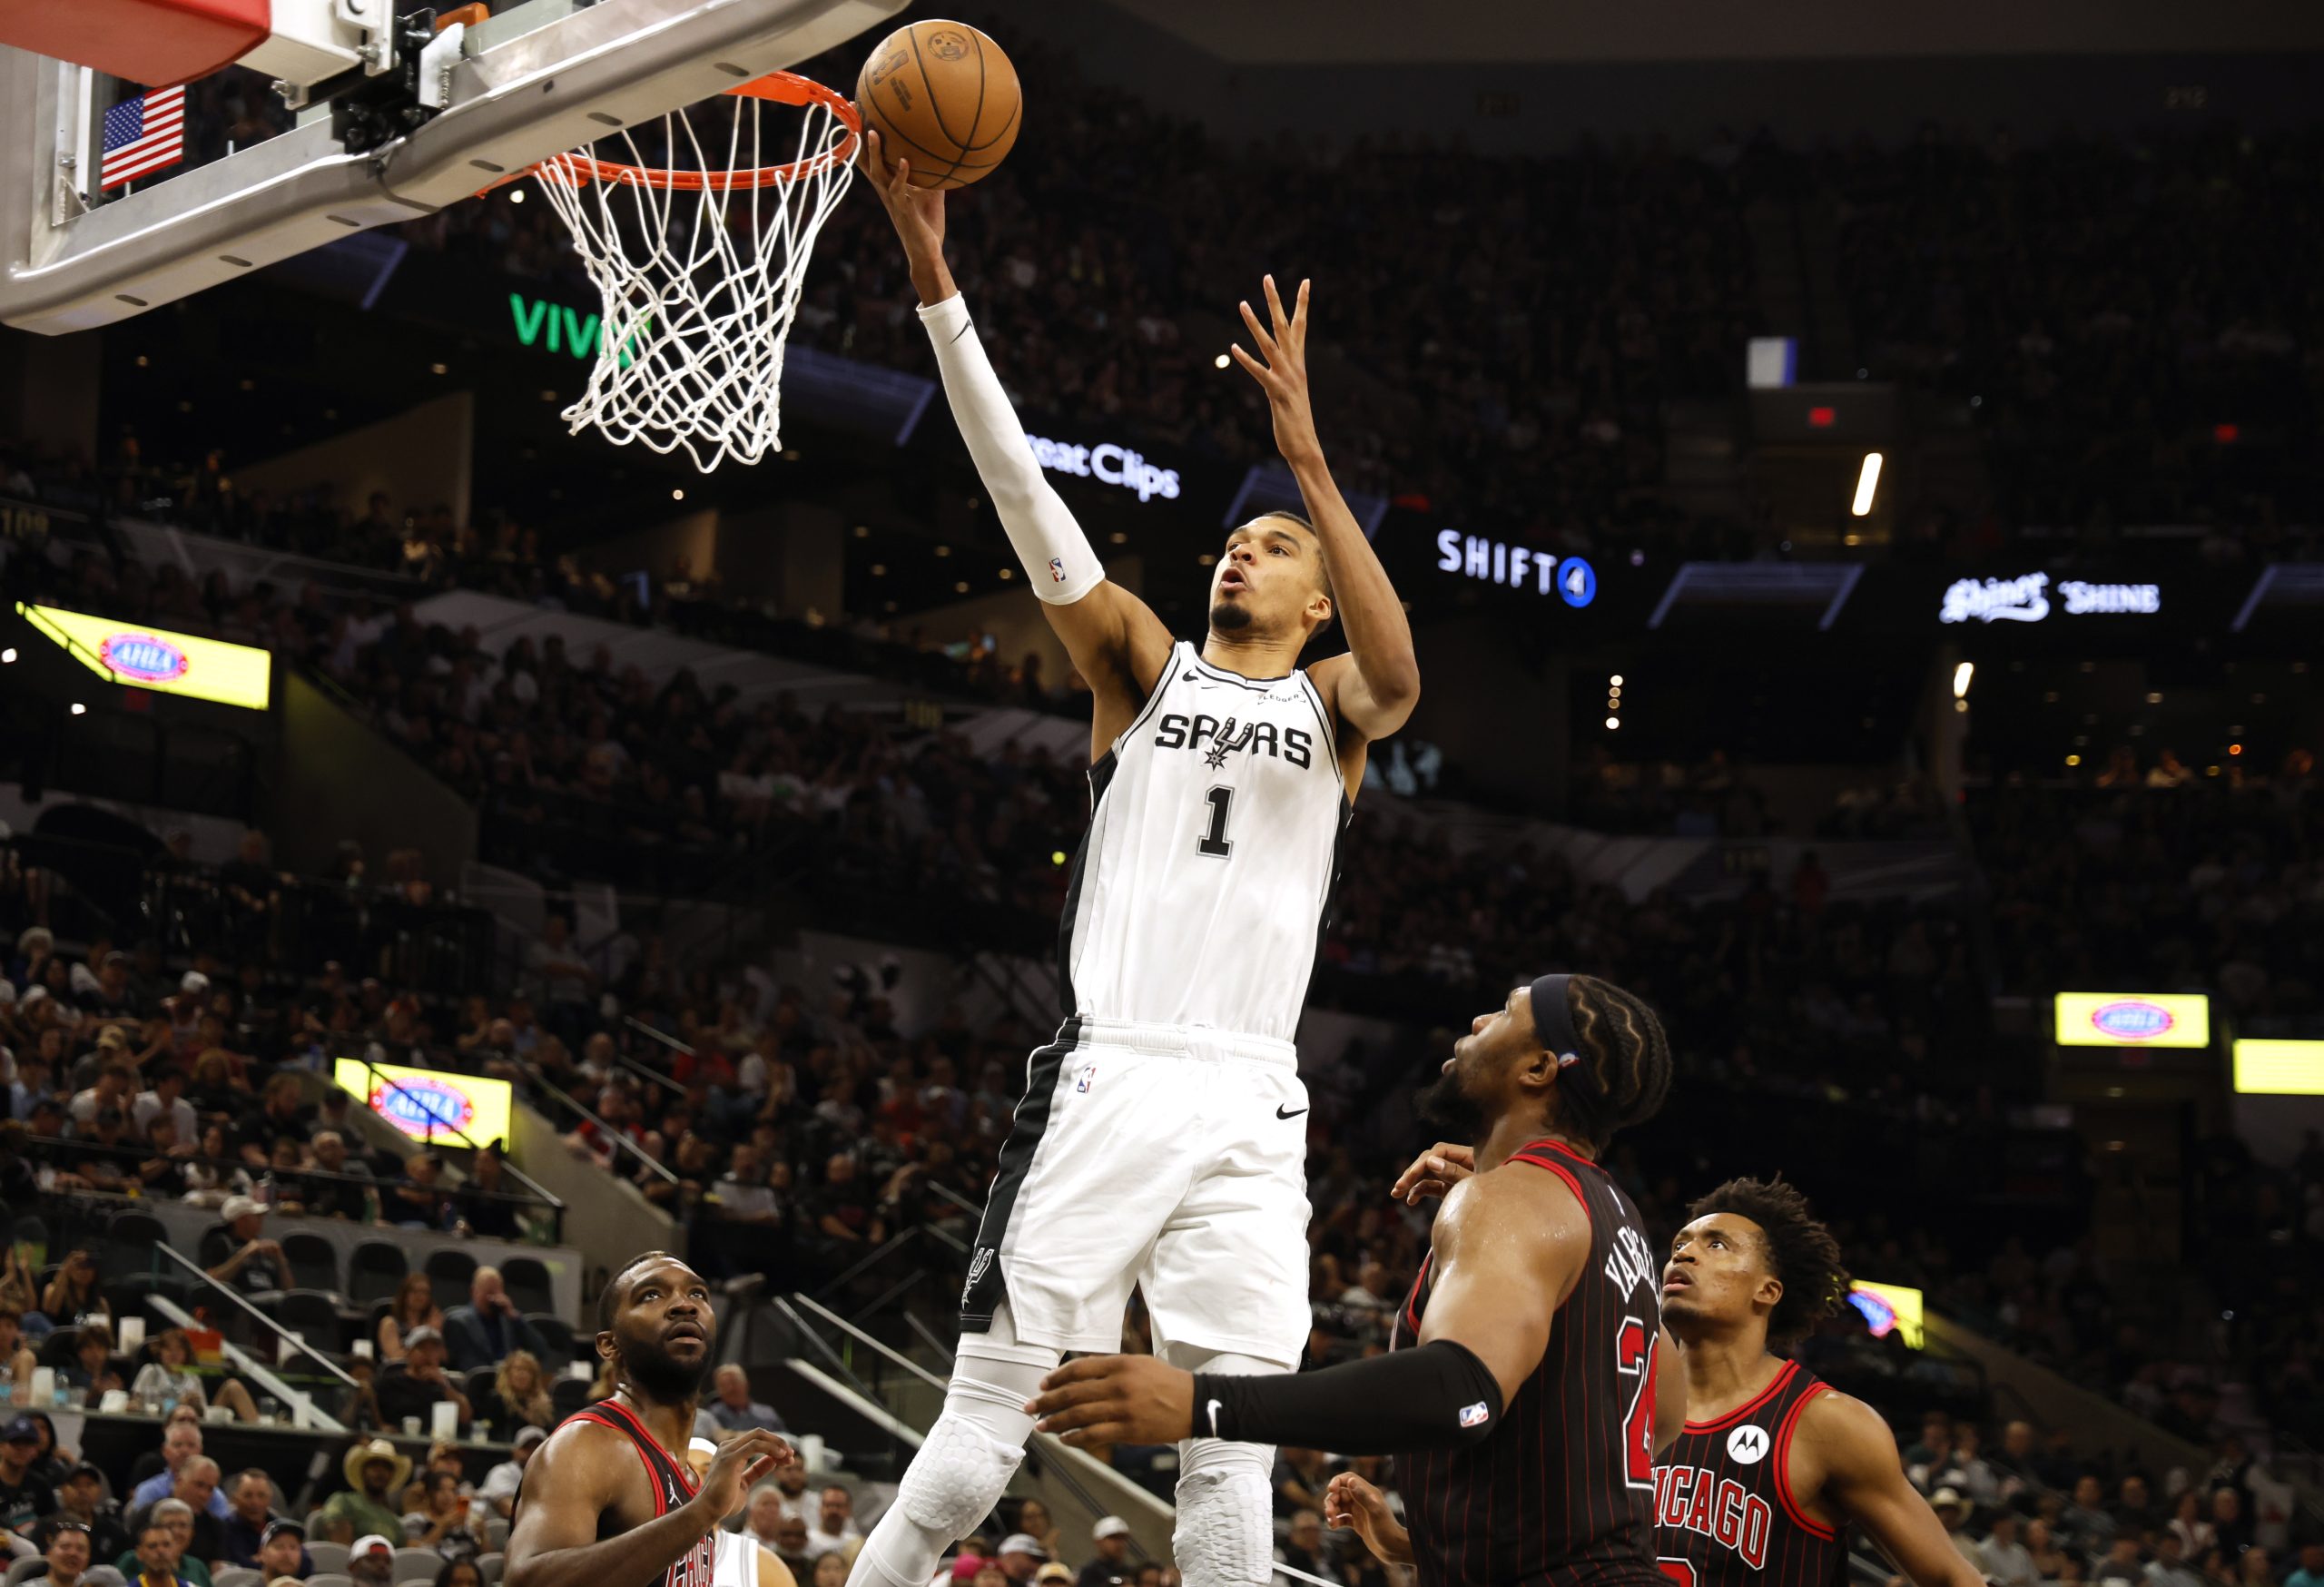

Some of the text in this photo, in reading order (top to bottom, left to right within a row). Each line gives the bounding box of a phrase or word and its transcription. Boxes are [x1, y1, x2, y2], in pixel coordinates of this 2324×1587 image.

[1025, 433, 1180, 503] eat Clips
[1437, 528, 1558, 596] SHIFT
[1155, 714, 1313, 772] SPURS
[1196, 784, 1236, 861] 1
[1650, 1464, 1772, 1571] ICAGO
